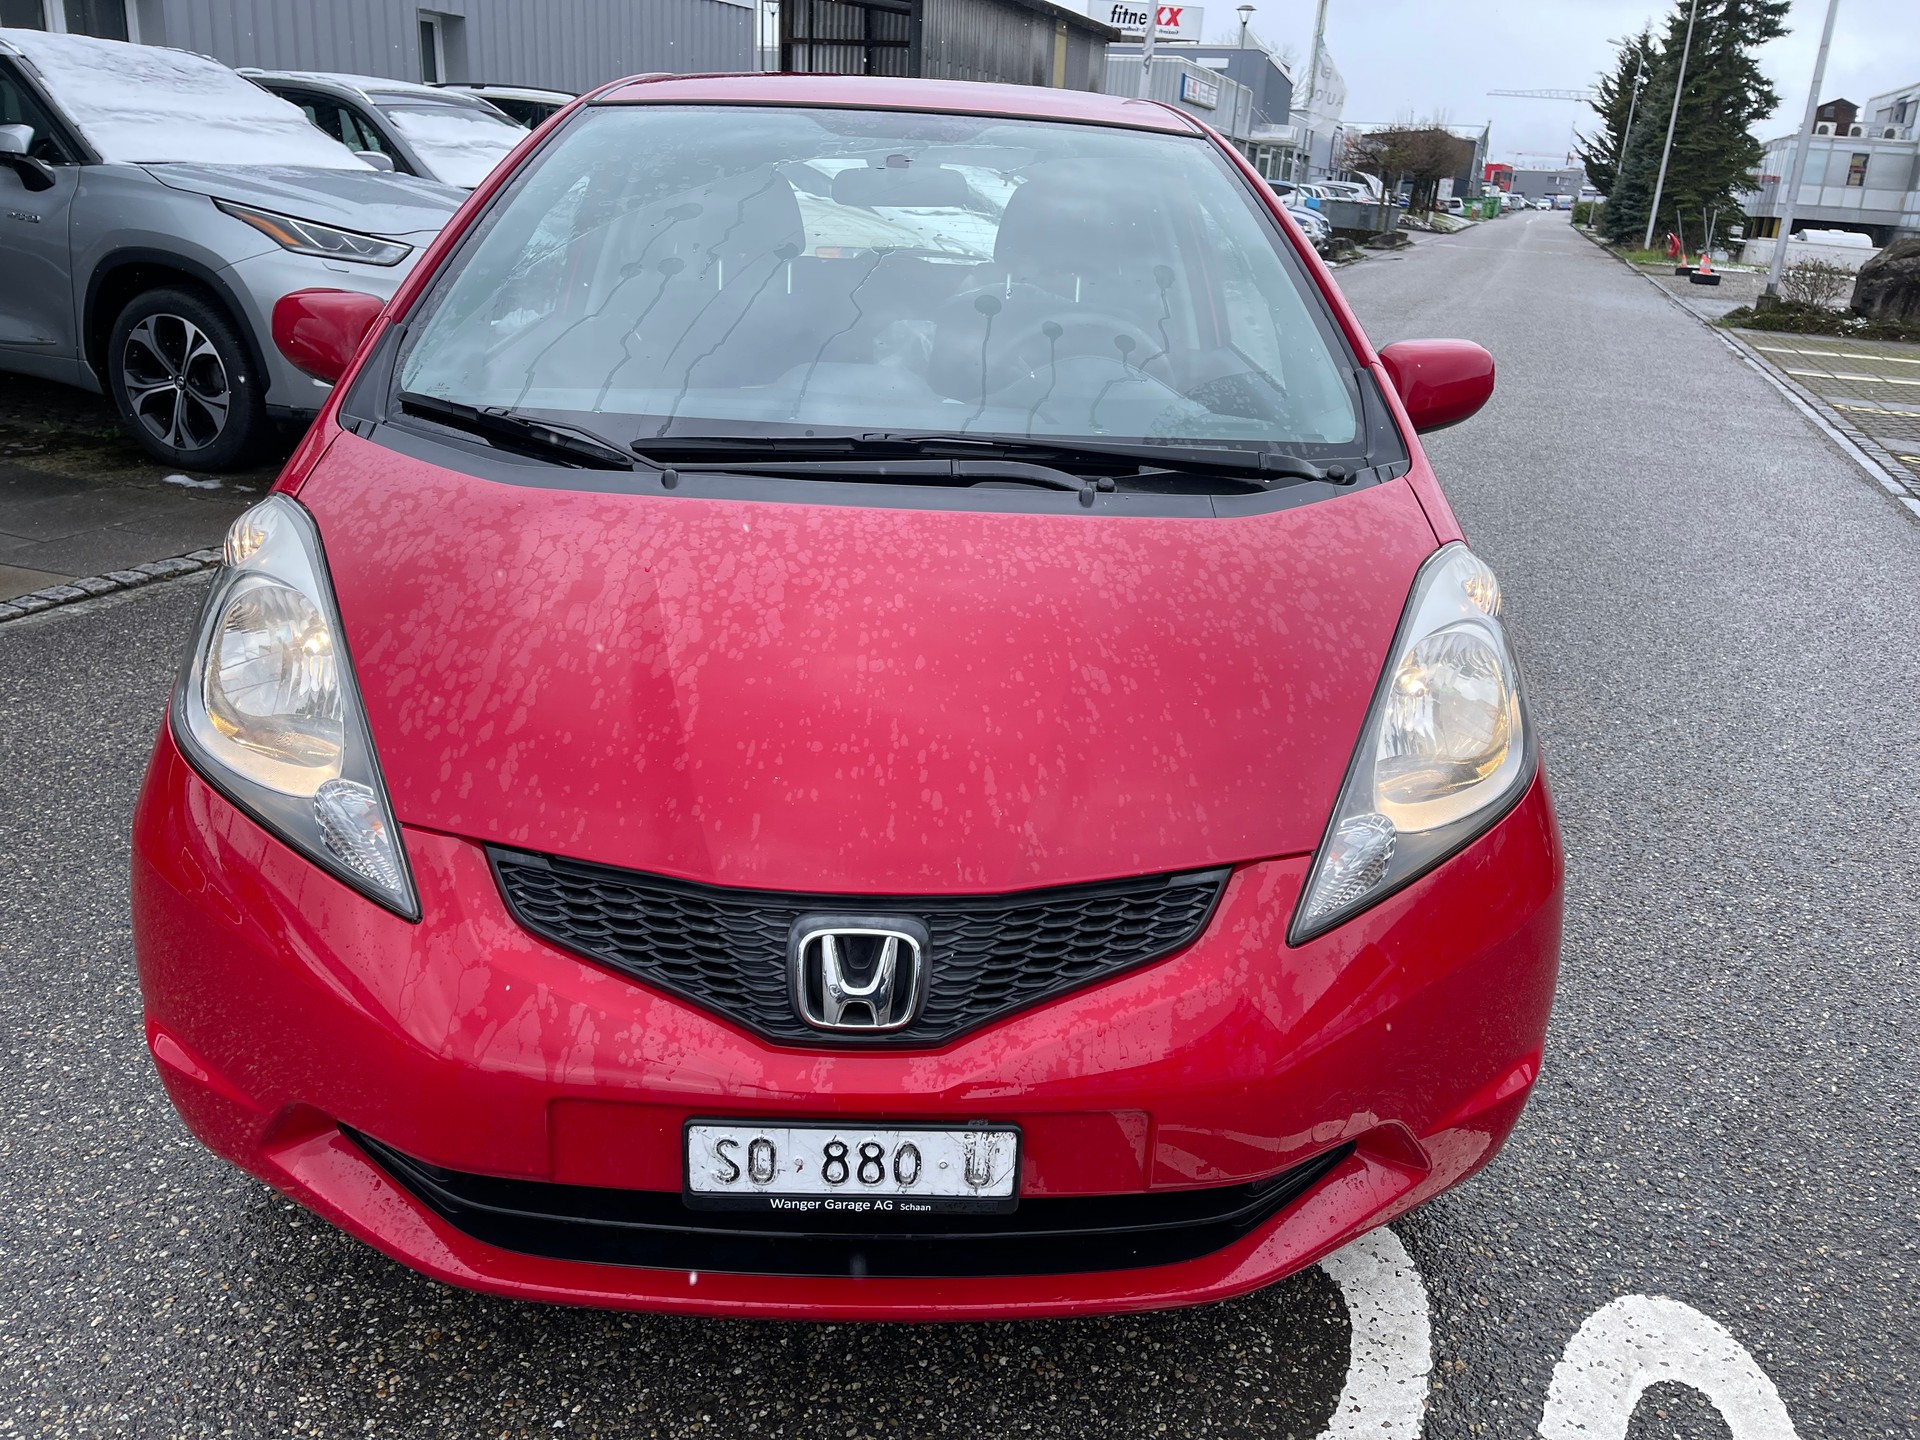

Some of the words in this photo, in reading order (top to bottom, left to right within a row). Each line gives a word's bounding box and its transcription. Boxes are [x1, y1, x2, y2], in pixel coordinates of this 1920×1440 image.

[712, 1137, 778, 1186] SO
[820, 1139, 922, 1187] 880
[770, 1198, 821, 1212] Wanger
[824, 1199, 871, 1212] Garage
[873, 1200, 893, 1210] AG
[900, 1203, 931, 1211] Schaan
